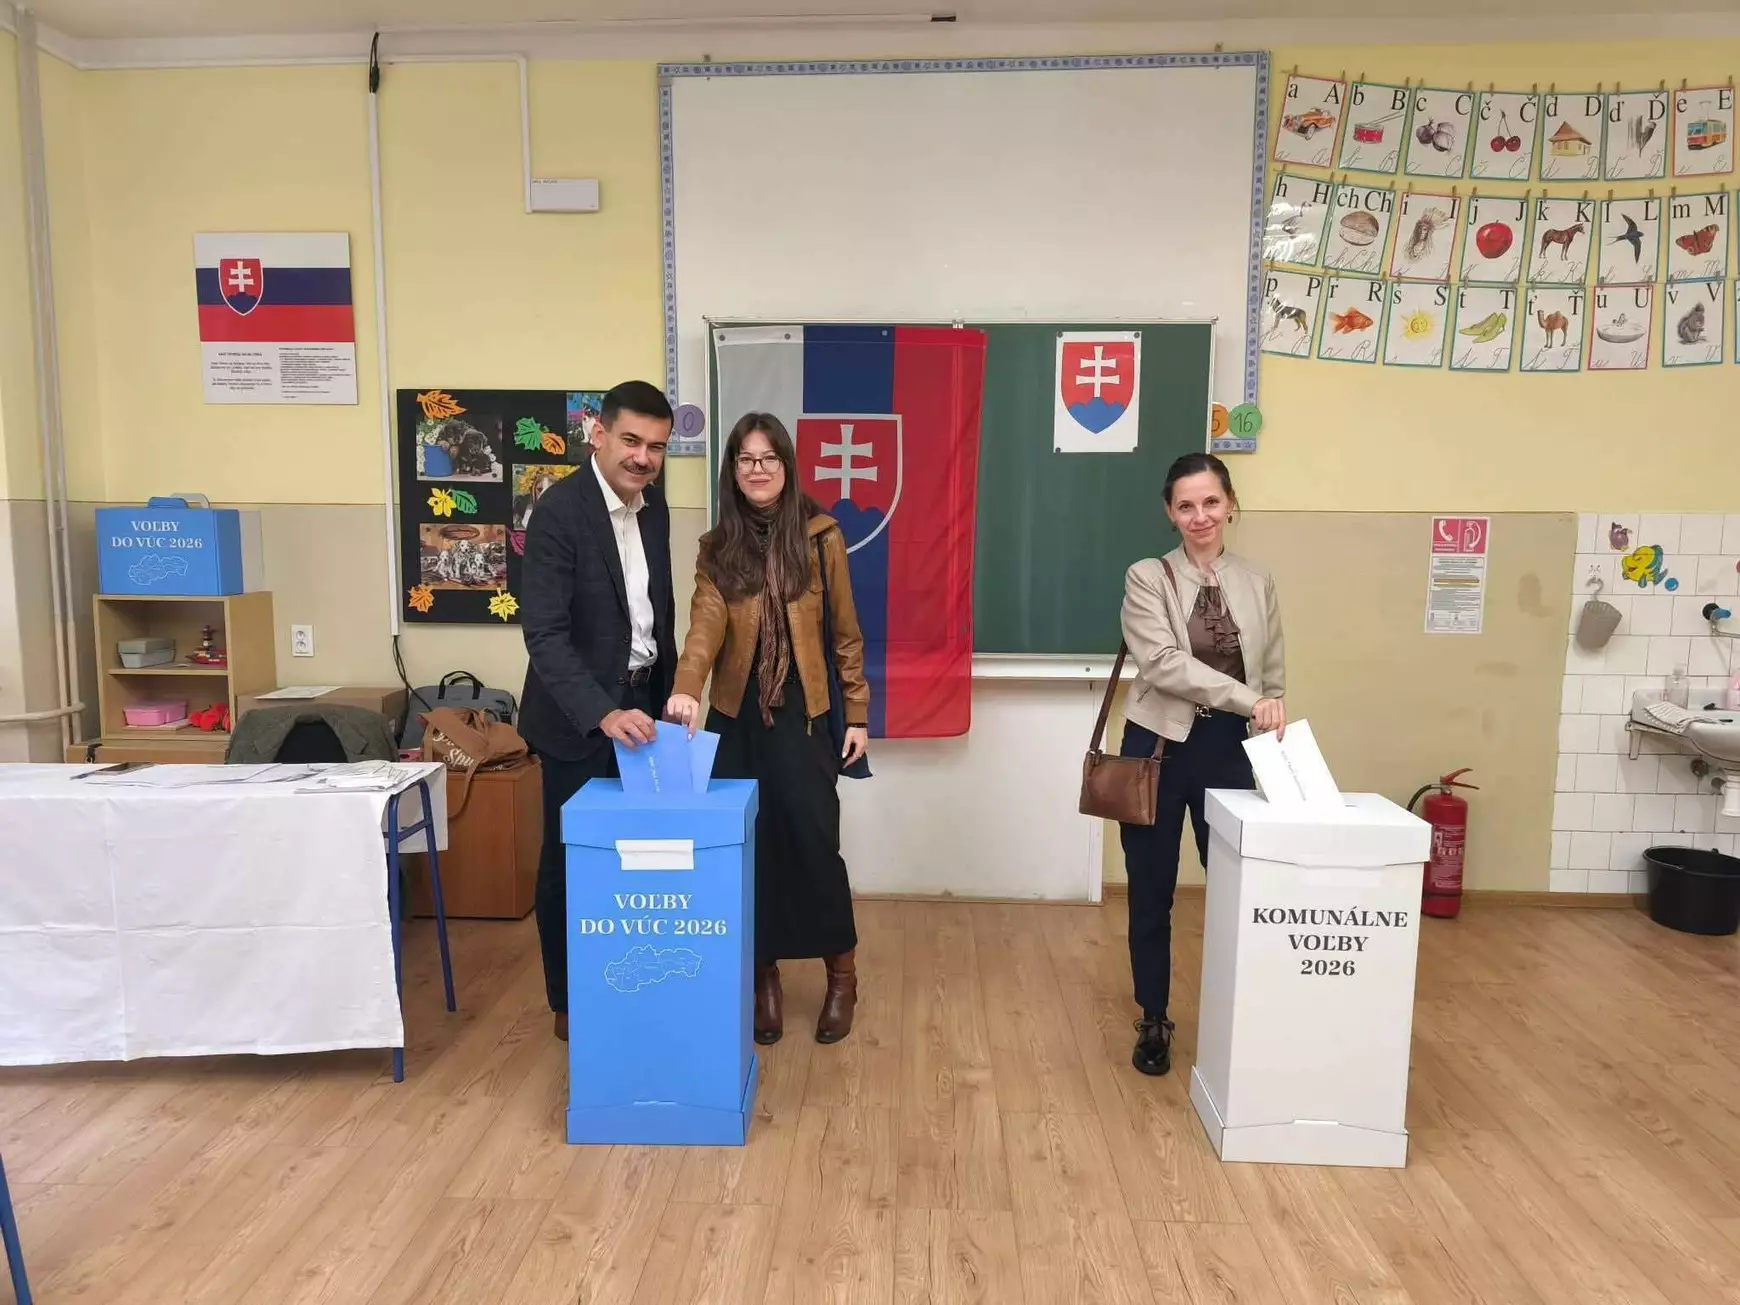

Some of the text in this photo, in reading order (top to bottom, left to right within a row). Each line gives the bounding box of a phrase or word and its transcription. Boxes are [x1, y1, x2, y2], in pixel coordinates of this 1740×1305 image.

[1288, 83, 1340, 104] a A
[1353, 85, 1406, 110] b B
[1677, 90, 1732, 113] e E
[1416, 94, 1471, 115] c C
[1480, 96, 1536, 122] č Č
[1546, 96, 1601, 117] d D
[1609, 93, 1665, 123] ď Ď
[1276, 177, 1330, 205] h H
[1337, 188, 1392, 213] ch Ch
[1403, 194, 1457, 219] i I
[1469, 199, 1525, 225] j J
[1538, 201, 1591, 223] k K
[1645, 201, 1658, 221] L
[1673, 196, 1725, 219] m M
[1265, 277, 1321, 297] p P
[1329, 282, 1383, 302] r R
[1393, 285, 1448, 306] s S
[1668, 290, 1678, 304] v
[1706, 282, 1720, 302] V
[1459, 290, 1514, 309] t T
[1528, 290, 1583, 315] ť Ť
[1597, 288, 1648, 309] u U
[1233, 412, 1253, 432] 16
[111, 536, 133, 547] DO
[169, 538, 203, 548] 2026
[614, 893, 692, 910] VOĽBY
[580, 915, 727, 935] DO VÚC 2026
[1252, 905, 1408, 928] KOMUNÁLNE
[1288, 934, 1369, 952] VOĽBY
[1300, 959, 1356, 977] 2026
